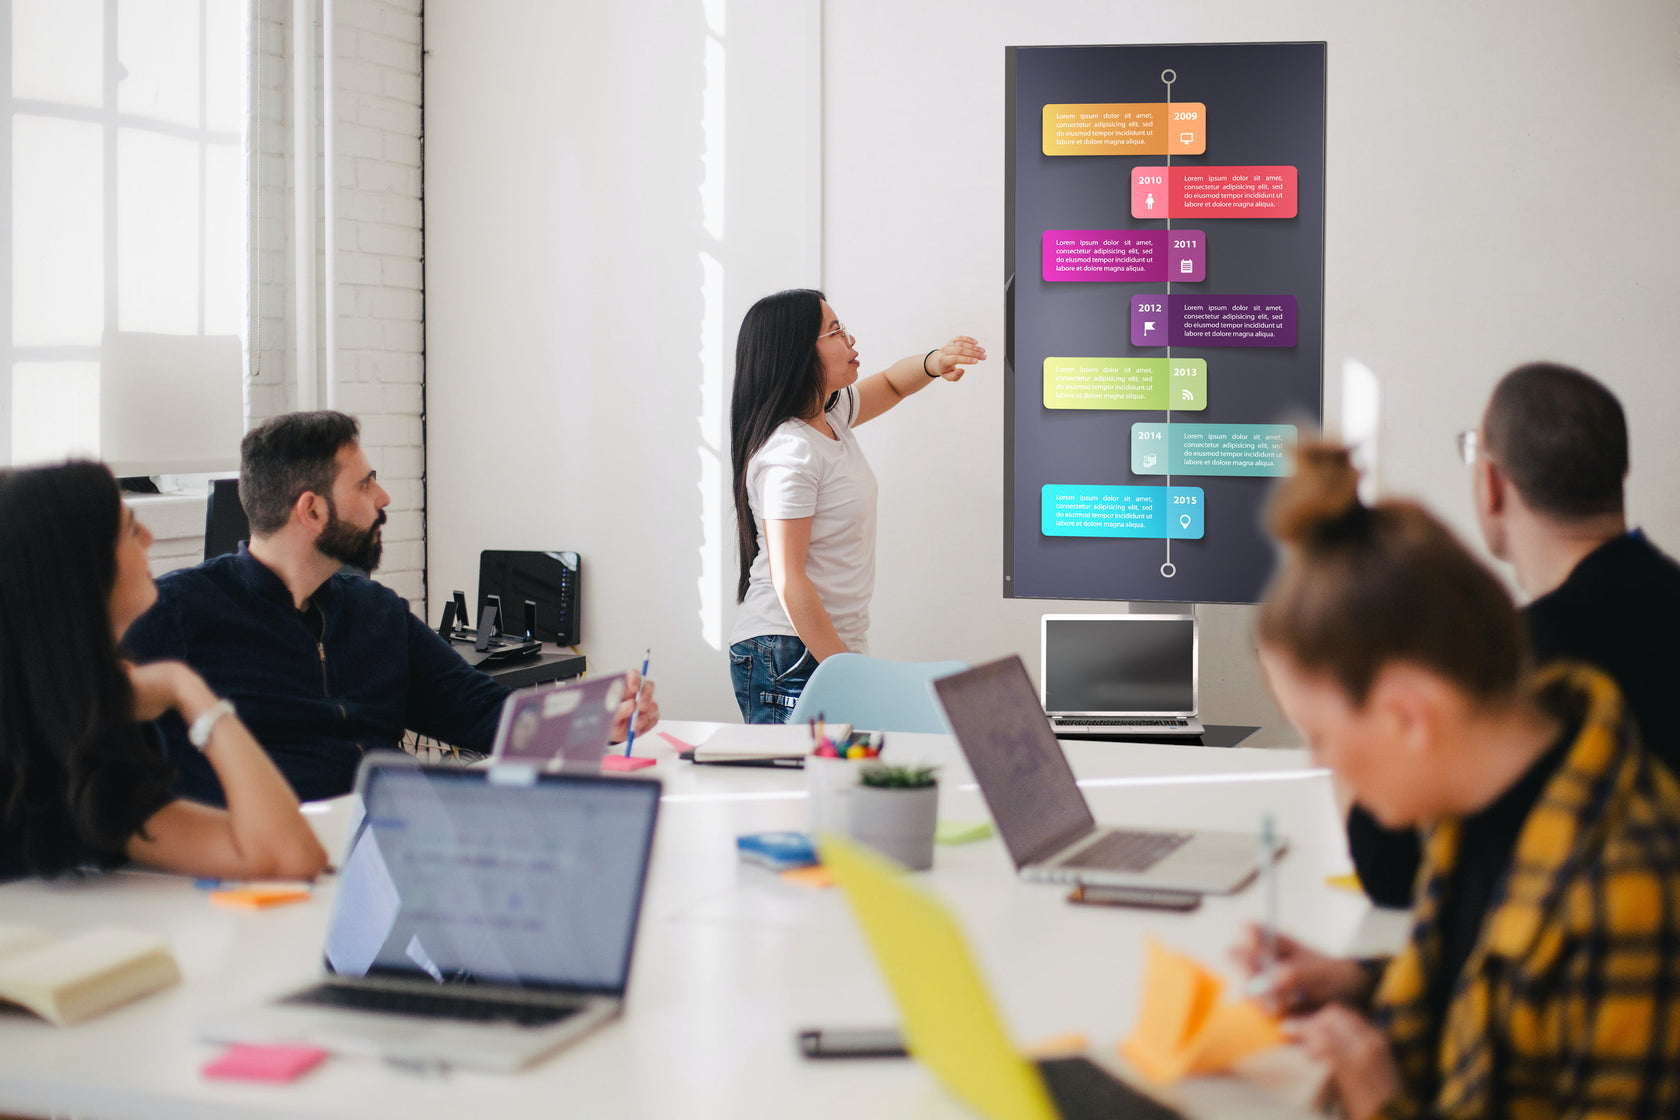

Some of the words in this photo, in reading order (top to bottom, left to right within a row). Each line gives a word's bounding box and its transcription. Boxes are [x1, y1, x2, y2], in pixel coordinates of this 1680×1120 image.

[1174, 112, 1198, 121] 2009
[1138, 176, 1162, 185] 2010
[1174, 240, 1197, 249] 2011
[1138, 304, 1162, 312] 2012
[1173, 368, 1197, 377] 2013
[1138, 431, 1162, 440] 2014
[1173, 495, 1197, 505] 2015
